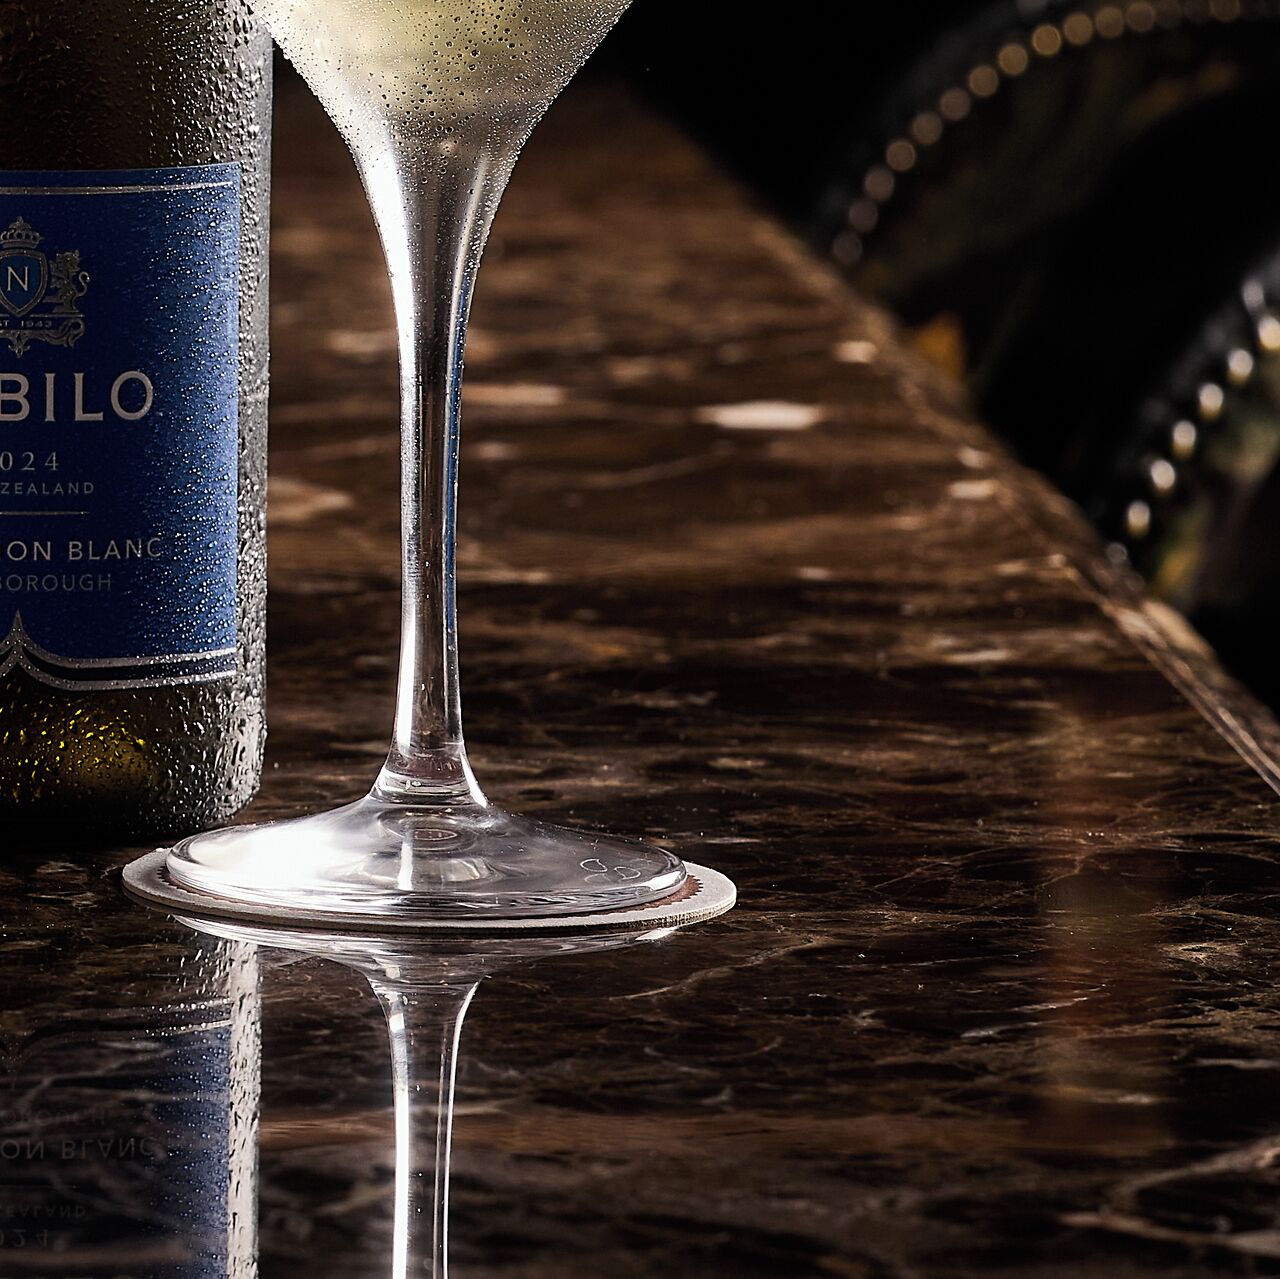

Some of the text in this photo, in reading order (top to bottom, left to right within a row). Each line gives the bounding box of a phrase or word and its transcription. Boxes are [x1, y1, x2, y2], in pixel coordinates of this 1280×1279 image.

[7, 266, 29, 291] N
[0, 480, 95, 496] ZEALAND
[68, 535, 163, 560] BLANC
